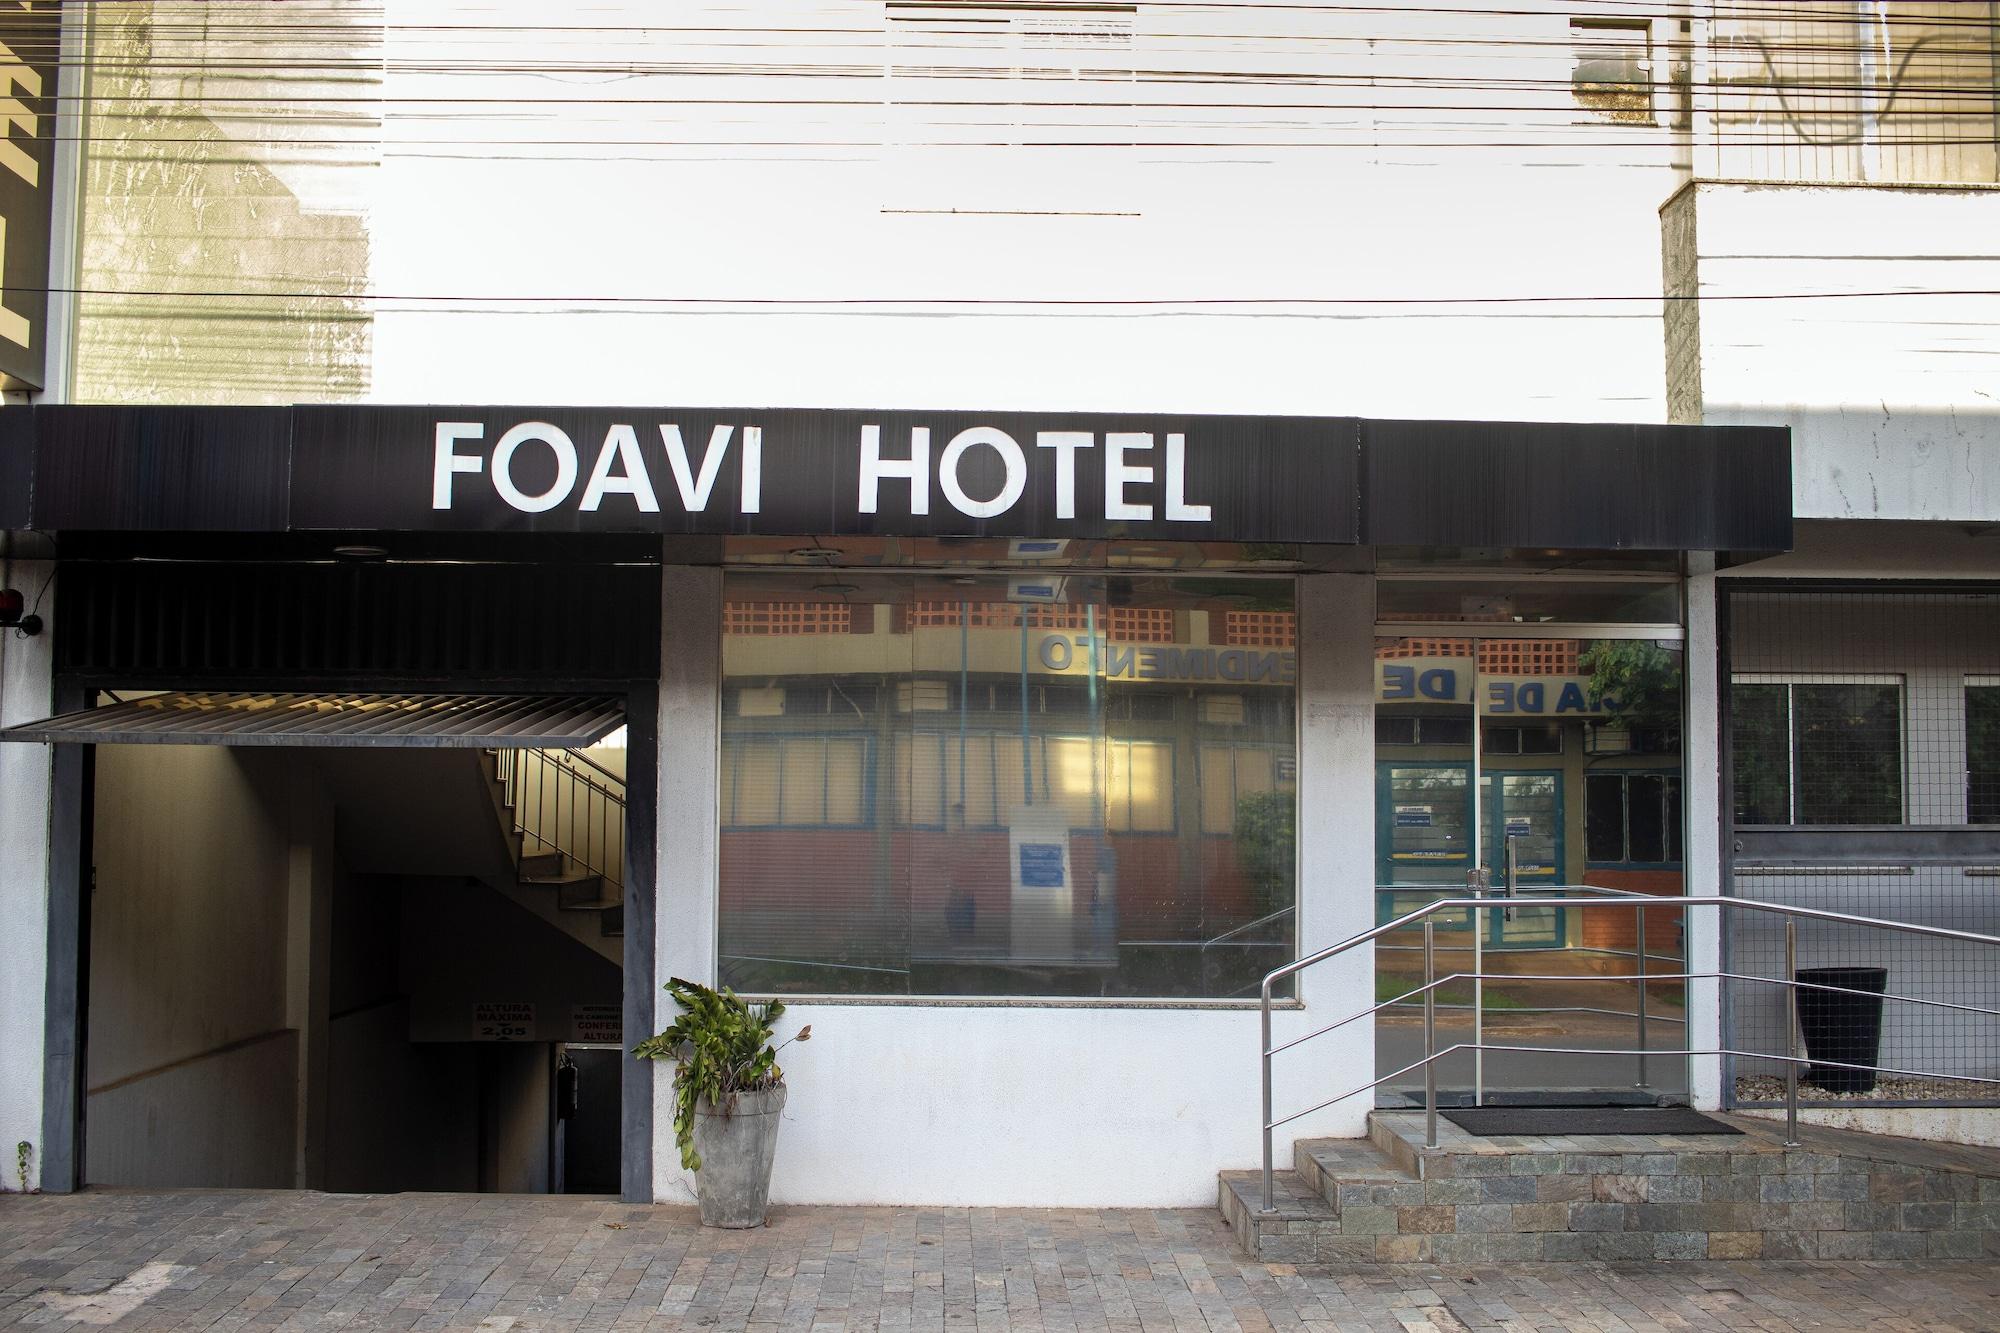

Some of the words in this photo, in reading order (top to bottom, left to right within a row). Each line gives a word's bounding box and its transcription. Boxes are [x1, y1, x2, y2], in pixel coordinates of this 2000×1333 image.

[432, 421, 763, 514] FOAVI
[857, 425, 1213, 523] HOTEL
[476, 1004, 532, 1012] ALTURA
